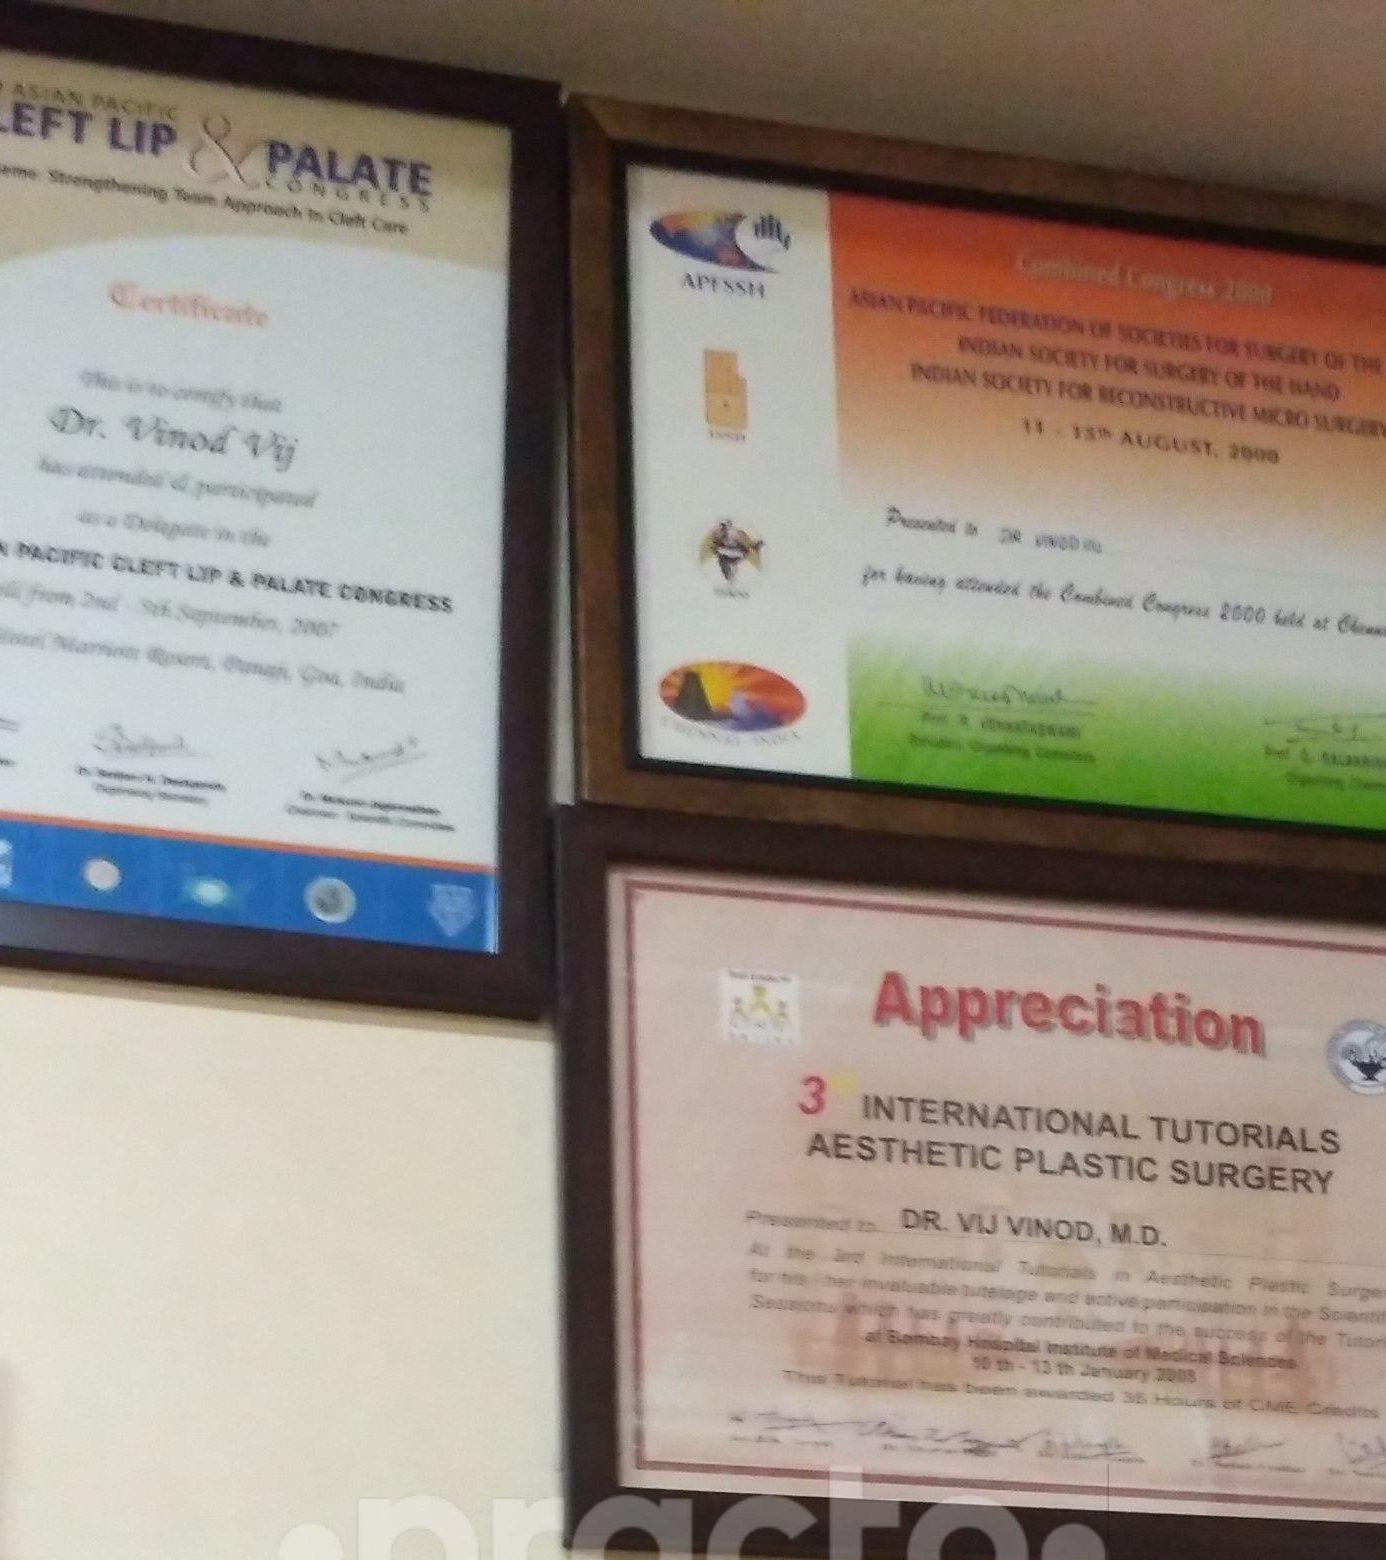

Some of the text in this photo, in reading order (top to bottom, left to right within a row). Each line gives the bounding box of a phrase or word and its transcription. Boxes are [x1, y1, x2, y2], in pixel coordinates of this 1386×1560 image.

[110, 116, 177, 157] LIP
[267, 139, 432, 196] PALATE
[49, 168, 169, 204] Strengthening
[225, 195, 302, 221] Approach
[266, 178, 431, 213] CONGRESS
[108, 281, 268, 327] Certificate
[907, 294, 972, 320] PACIFIC
[979, 305, 1085, 334] FEDERATION
[1116, 324, 1203, 351] SOCIETIES
[910, 362, 976, 386] INDIAN
[981, 370, 1051, 397] SOCIETY
[1058, 380, 1093, 401] FOR
[1098, 386, 1247, 422] RECONSTRUCTIVE
[1253, 406, 1308, 430] MICRO
[958, 335, 1340, 402] INDIAN SOCIETY FOR SURGERY OF THE HAND
[49, 406, 299, 472] Dr. Vinod Vij
[885, 505, 957, 533] Presented
[17, 541, 104, 570] PACIFIC
[113, 554, 180, 580] CLEFT
[229, 569, 246, 588] &
[253, 571, 332, 599] PALATE
[339, 581, 454, 614] CONGRESS
[955, 575, 1020, 597] attended
[1029, 582, 1051, 600] the
[1061, 581, 1133, 610] Combined
[1141, 591, 1211, 622] Congress
[1219, 601, 1266, 625] 2000
[1273, 607, 1306, 628] held
[872, 970, 1266, 1057] Appreciation
[862, 1093, 1140, 1141] INTERNATIONAL
[1148, 1114, 1341, 1155] TUTORIALS
[806, 1131, 1334, 1194] AESTHETIC PLASTIC SURGERY
[901, 1208, 948, 1233] DR.
[956, 1211, 998, 1236] VIJ
[1007, 1215, 1102, 1248] VINOD,
[1110, 1222, 1167, 1248] M.D.
[879, 1251, 1001, 1274] International
[1019, 1260, 1096, 1281] Tutorials
[1147, 1269, 1232, 1290] Aesthetic
[1248, 1276, 1310, 1295] Plastic
[888, 1329, 960, 1352] Bombay
[968, 1335, 1040, 1354] Hospital
[1145, 1346, 1212, 1365] Medical
[1218, 1350, 1298, 1370] Sciences
